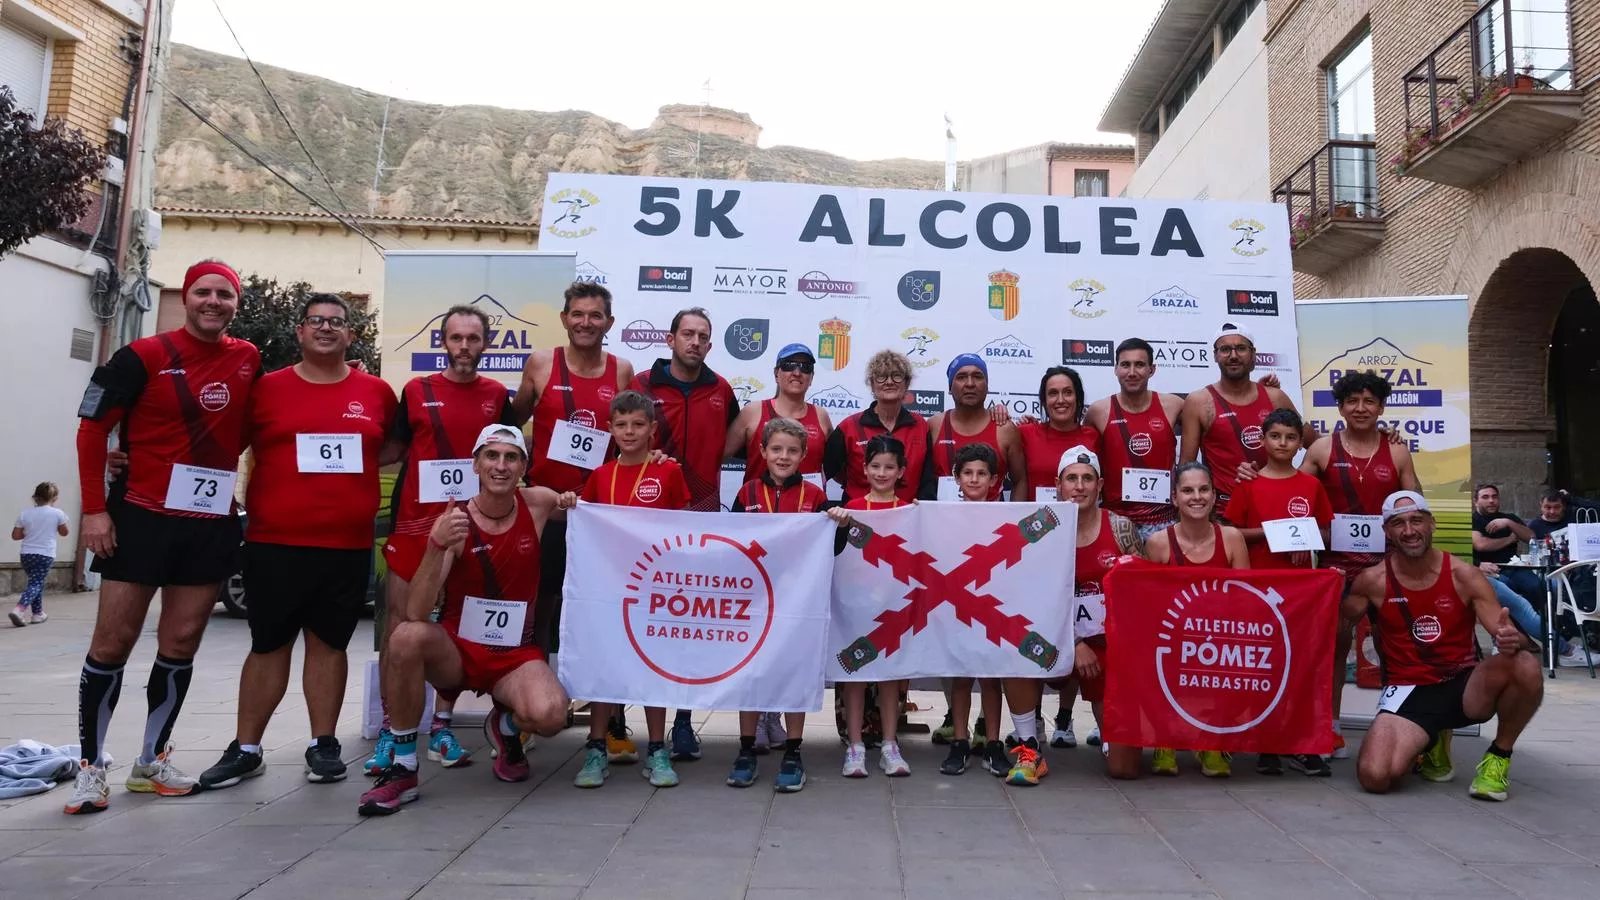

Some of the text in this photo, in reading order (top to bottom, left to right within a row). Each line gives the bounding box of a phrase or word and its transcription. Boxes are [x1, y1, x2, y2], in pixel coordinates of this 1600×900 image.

[634, 186, 1204, 258] 5K ALCOLEA
[576, 275, 608, 284] AZAL
[663, 269, 687, 280] barri
[714, 273, 787, 288] MAYOR
[906, 276, 927, 287] Flor
[806, 281, 853, 291] ANTONIO
[911, 283, 935, 303] Sal
[1152, 298, 1198, 308] BRAZAL
[1250, 293, 1273, 304] barri
[733, 324, 754, 336] Flor
[430, 329, 532, 349] BZAL
[738, 332, 763, 352] Sal
[985, 347, 1033, 358] BRAZAL
[1086, 343, 1109, 354] barri
[1155, 348, 1208, 361] AYOR
[436, 356, 446, 369] EL
[489, 354, 523, 369] ARAGÓN
[1358, 355, 1398, 366] ARROZ
[1329, 368, 1428, 387] BZAL
[812, 397, 861, 408] BRAZAL
[915, 393, 940, 405] barri
[1386, 391, 1419, 405] ARAGÓN
[987, 399, 1040, 415] AYOR
[1310, 420, 1329, 433] EL
[1404, 420, 1445, 436] QUE
[570, 434, 594, 453] 96
[319, 443, 343, 460] 61
[440, 468, 464, 485] 60
[1139, 476, 1158, 491] 87
[193, 477, 218, 498] 73
[1288, 525, 1301, 538] 2
[1349, 523, 1371, 538] 30
[652, 570, 754, 590] ATLETISMO
[648, 588, 753, 621] PÓMEZ
[484, 609, 509, 628] 70
[646, 625, 750, 643] BARBASTRO
[1183, 617, 1274, 637] ATLETISMO
[1180, 635, 1273, 669] PÓMEZ
[1179, 674, 1272, 692] BARBASTRO
